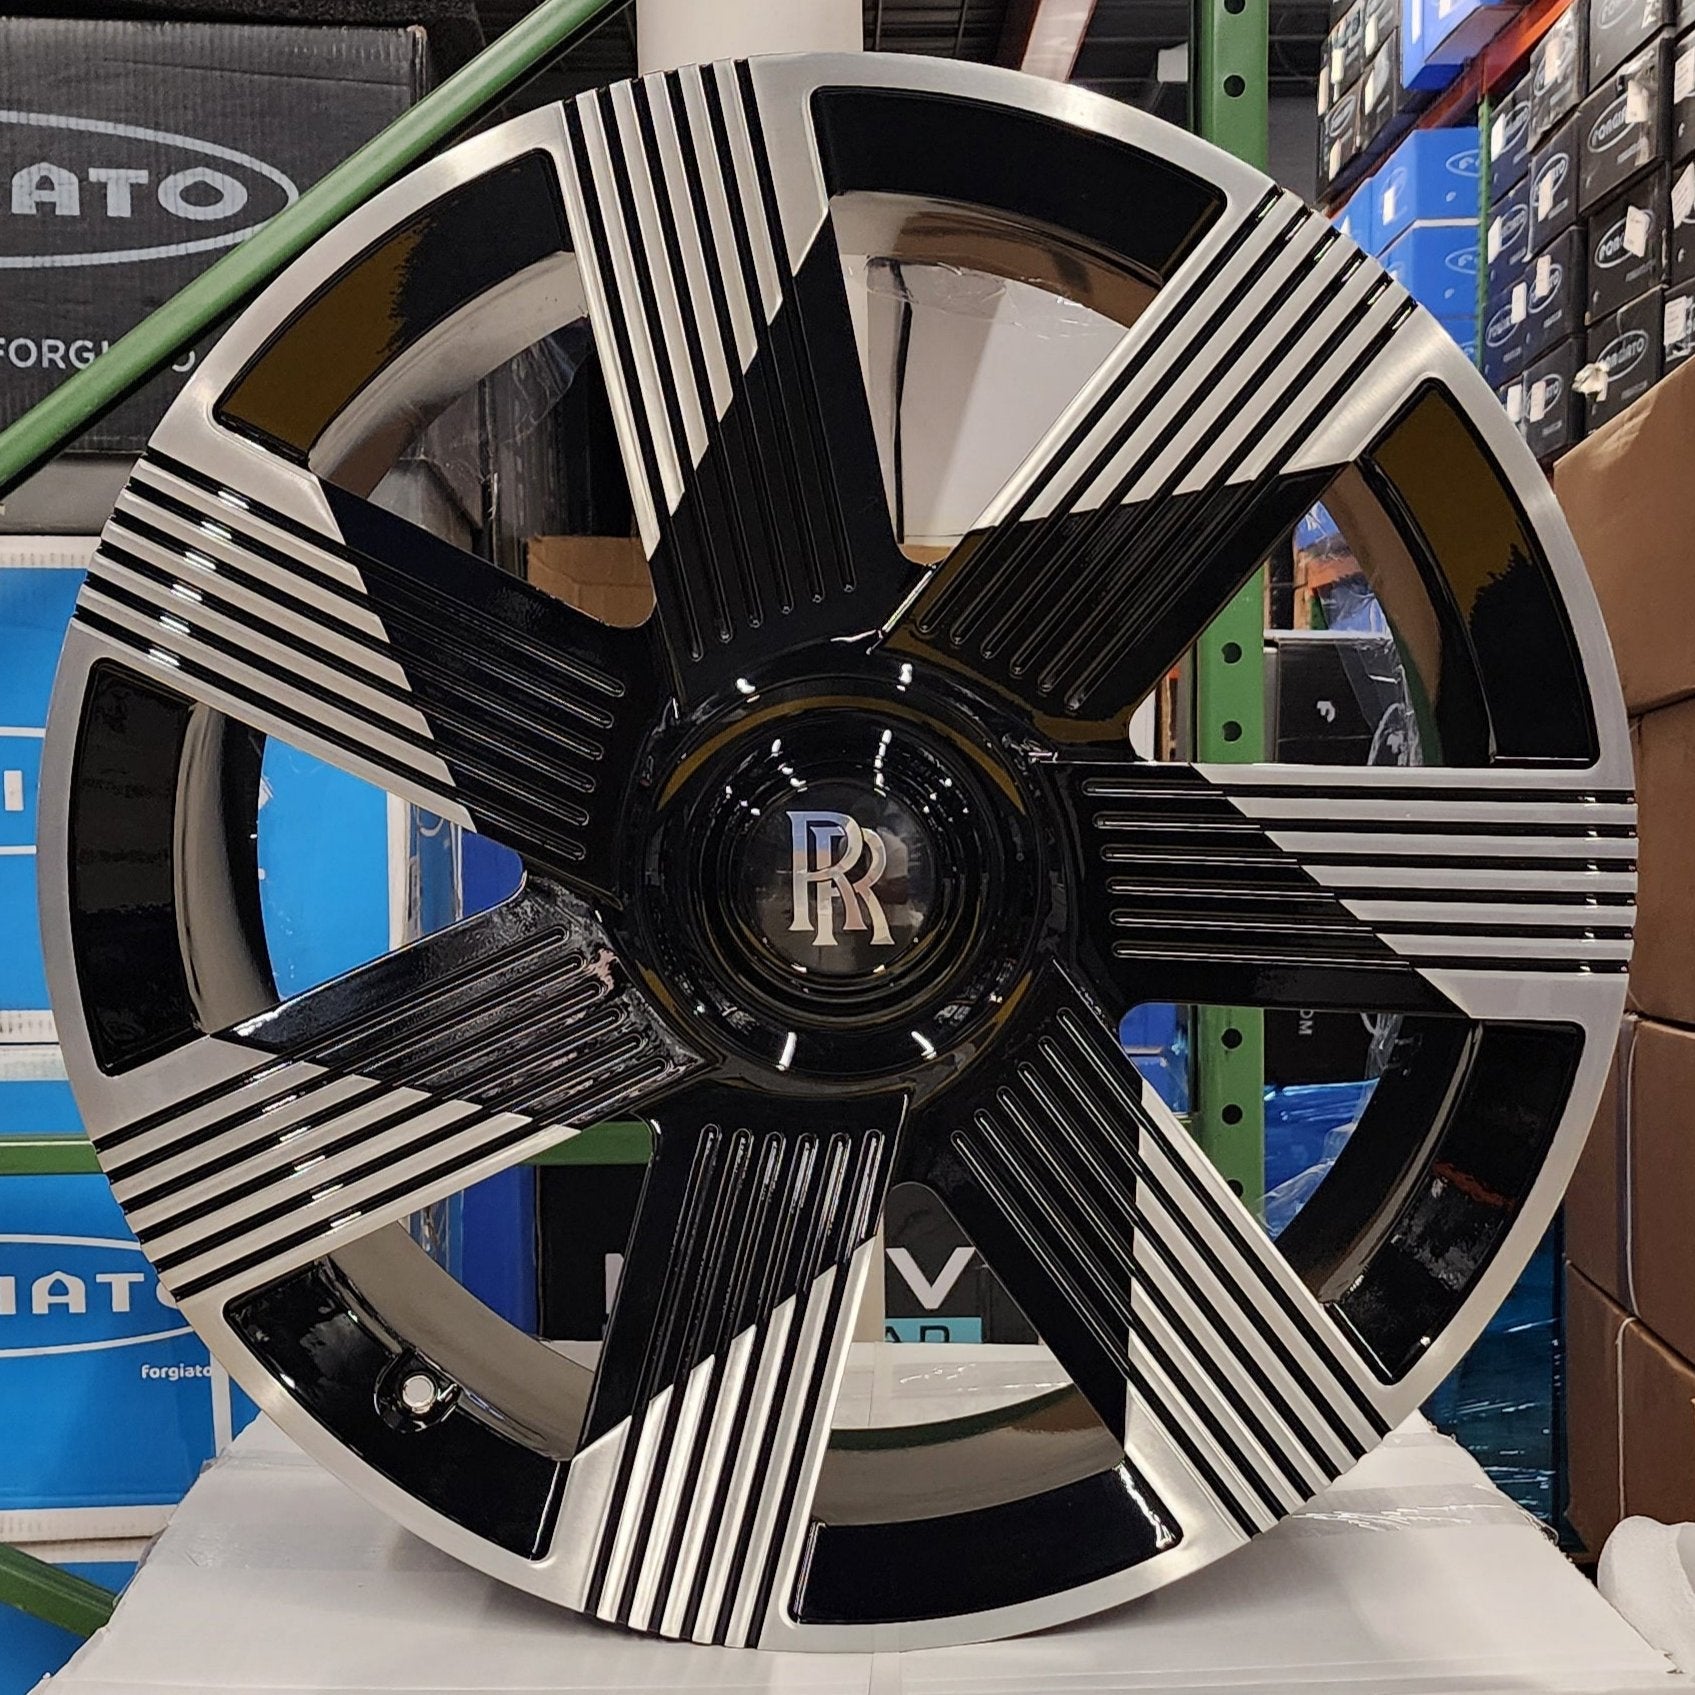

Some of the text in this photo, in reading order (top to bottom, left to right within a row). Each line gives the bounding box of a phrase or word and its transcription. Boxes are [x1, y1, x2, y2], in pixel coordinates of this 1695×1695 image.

[11, 161, 249, 221] ATO
[786, 811, 895, 946] RR
[0, 1271, 178, 1314] IAT
